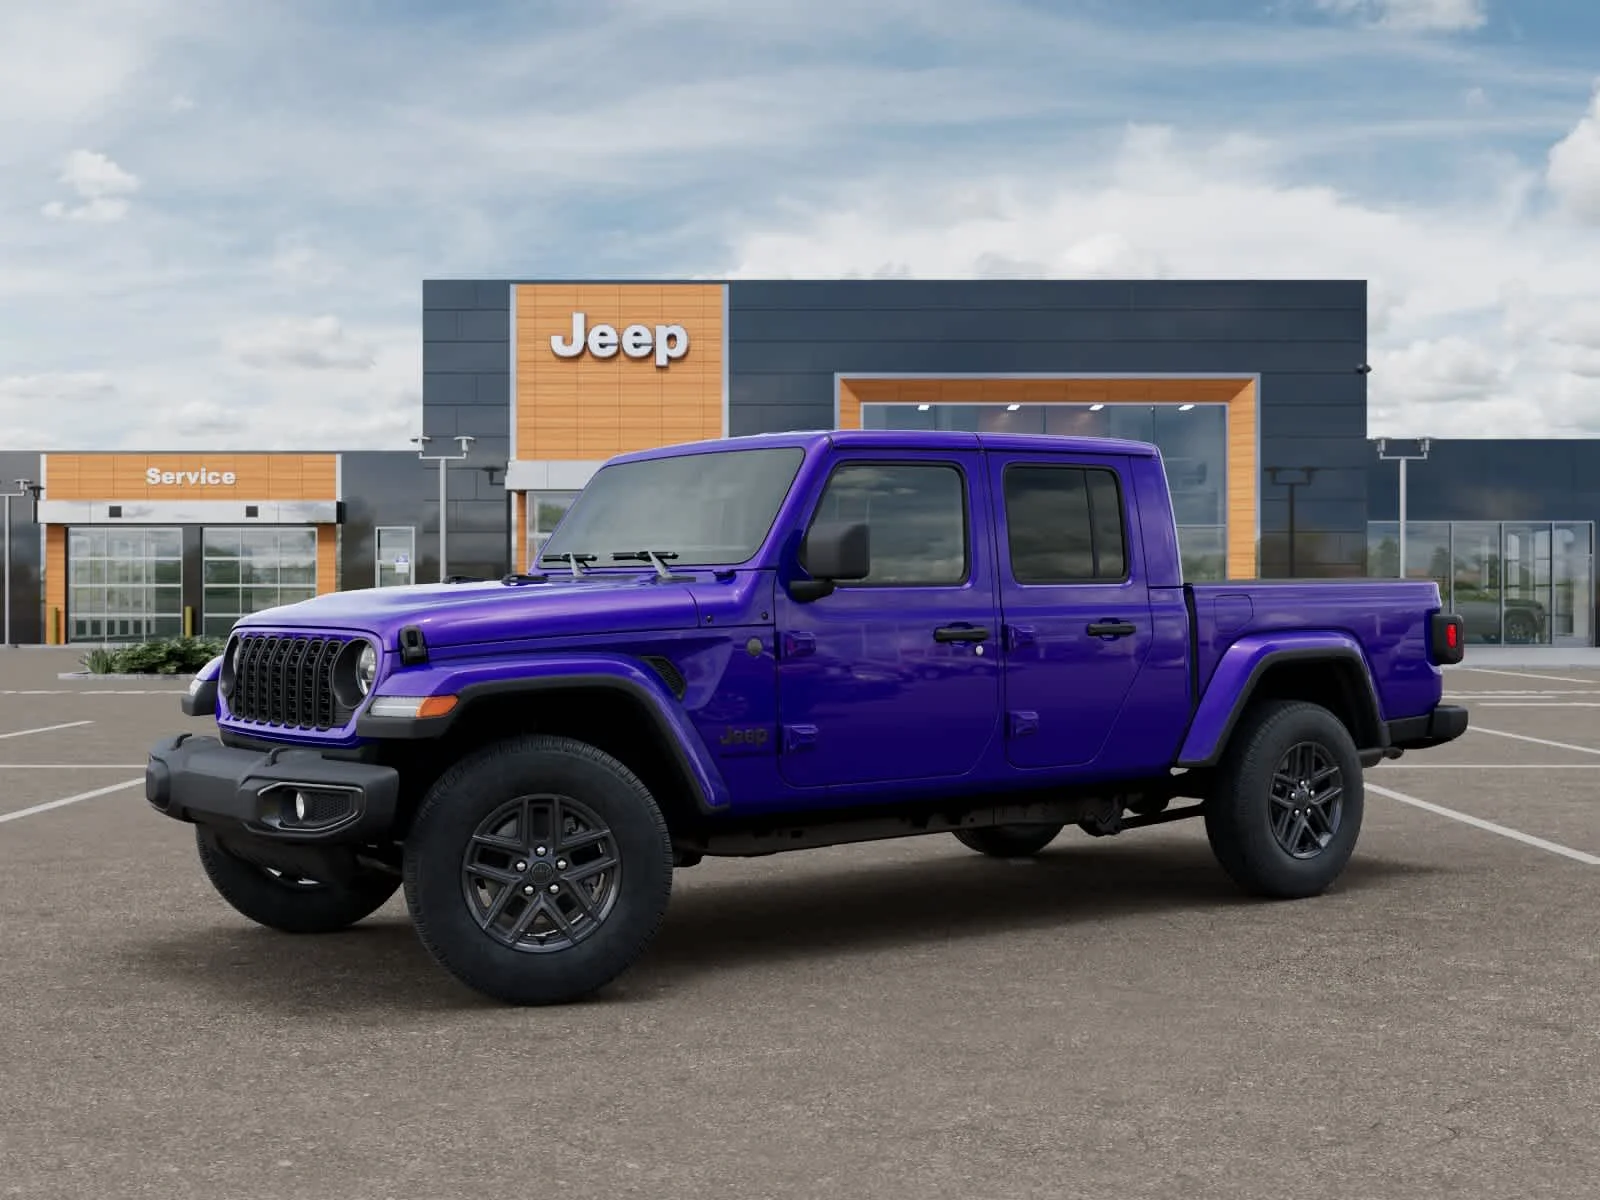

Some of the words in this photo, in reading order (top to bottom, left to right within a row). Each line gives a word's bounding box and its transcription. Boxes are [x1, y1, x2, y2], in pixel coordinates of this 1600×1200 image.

[550, 311, 689, 368] Jeep
[146, 467, 237, 486] Service
[719, 725, 768, 748] Jeep
